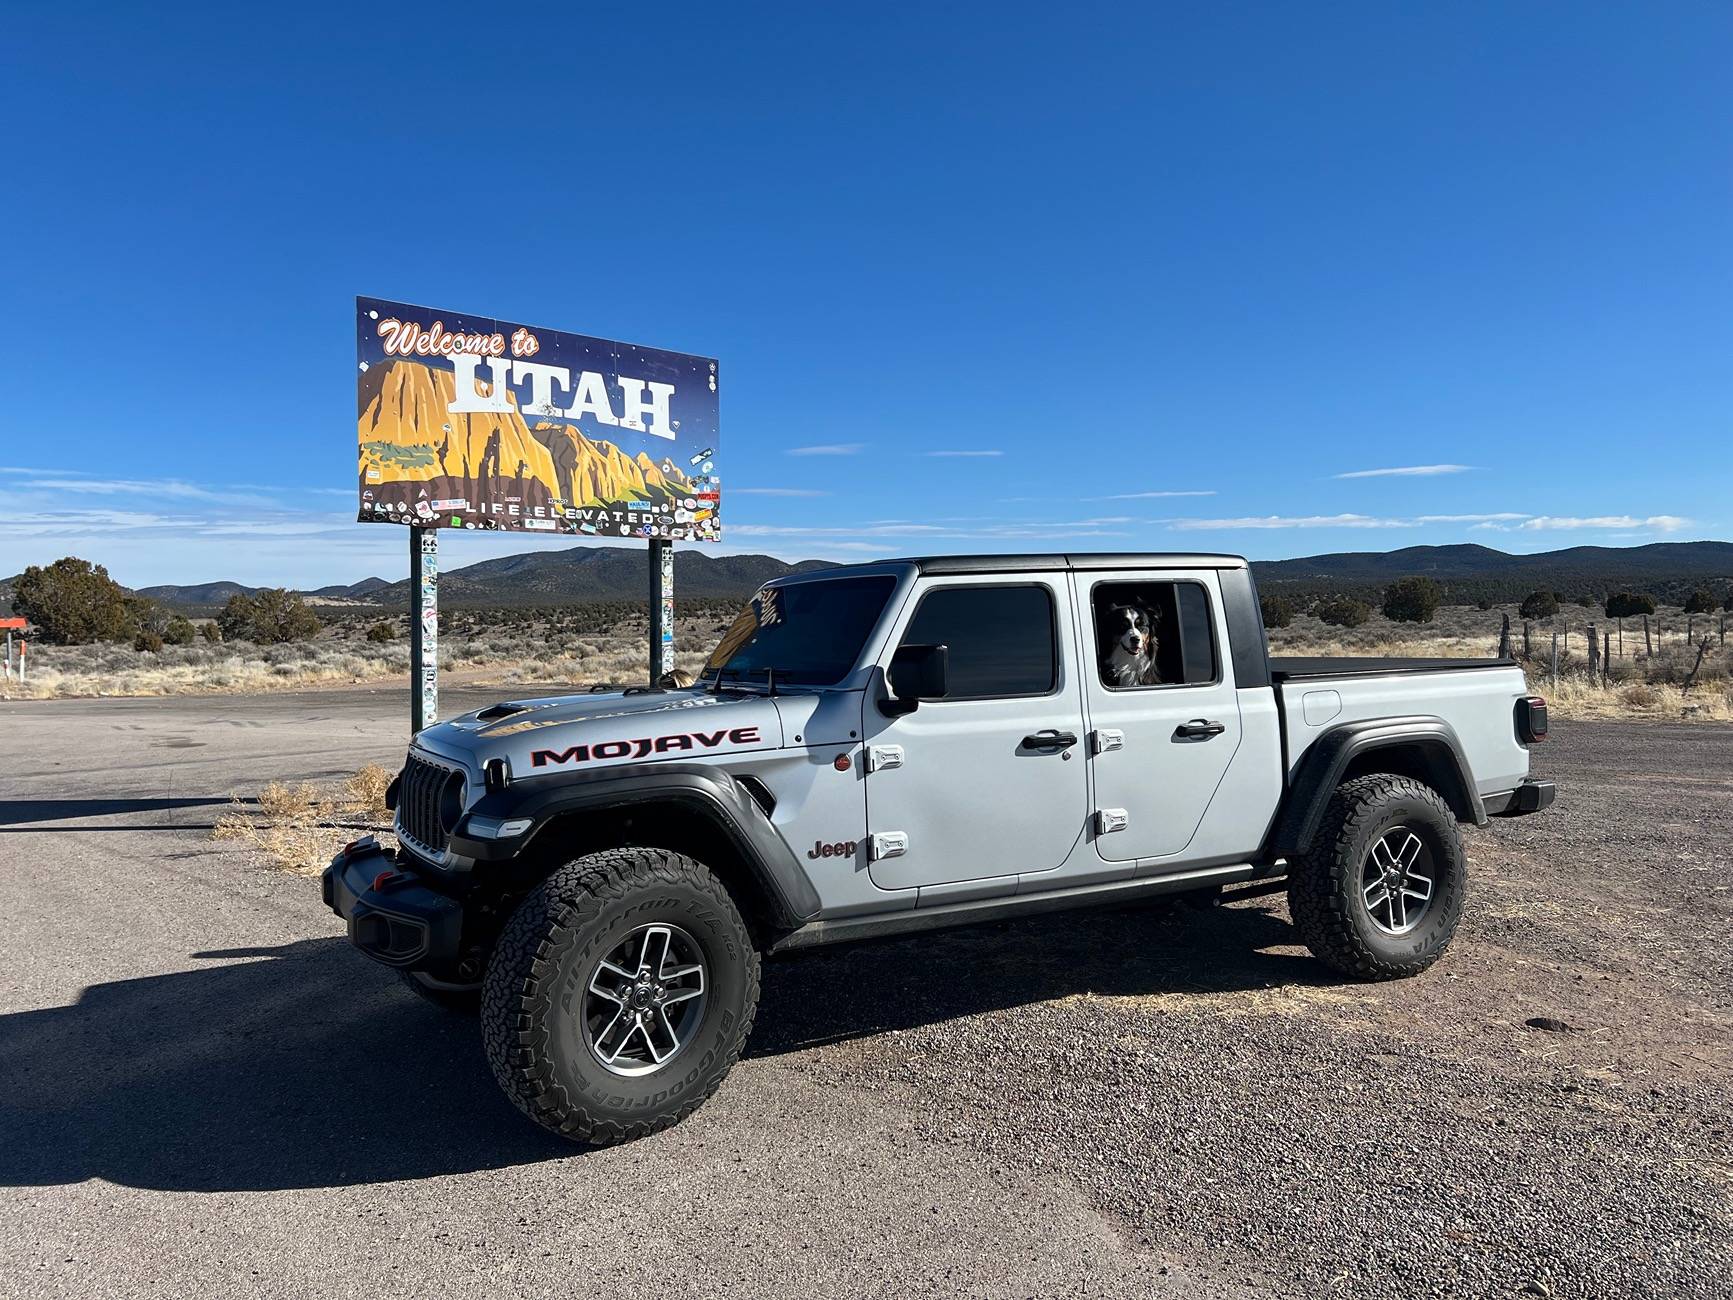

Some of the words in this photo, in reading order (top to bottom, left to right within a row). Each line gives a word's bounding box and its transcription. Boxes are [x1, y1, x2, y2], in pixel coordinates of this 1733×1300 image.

[378, 318, 506, 357] Welcome
[511, 328, 540, 357] to
[447, 353, 676, 441] UTAH
[465, 501, 520, 516] LIFE
[534, 506, 654, 524] ELEVATED
[530, 726, 761, 768] MOJAVE
[807, 840, 857, 859] Jeep
[684, 898, 724, 936] T/A
[591, 1008, 735, 1112] BFGoodrich
